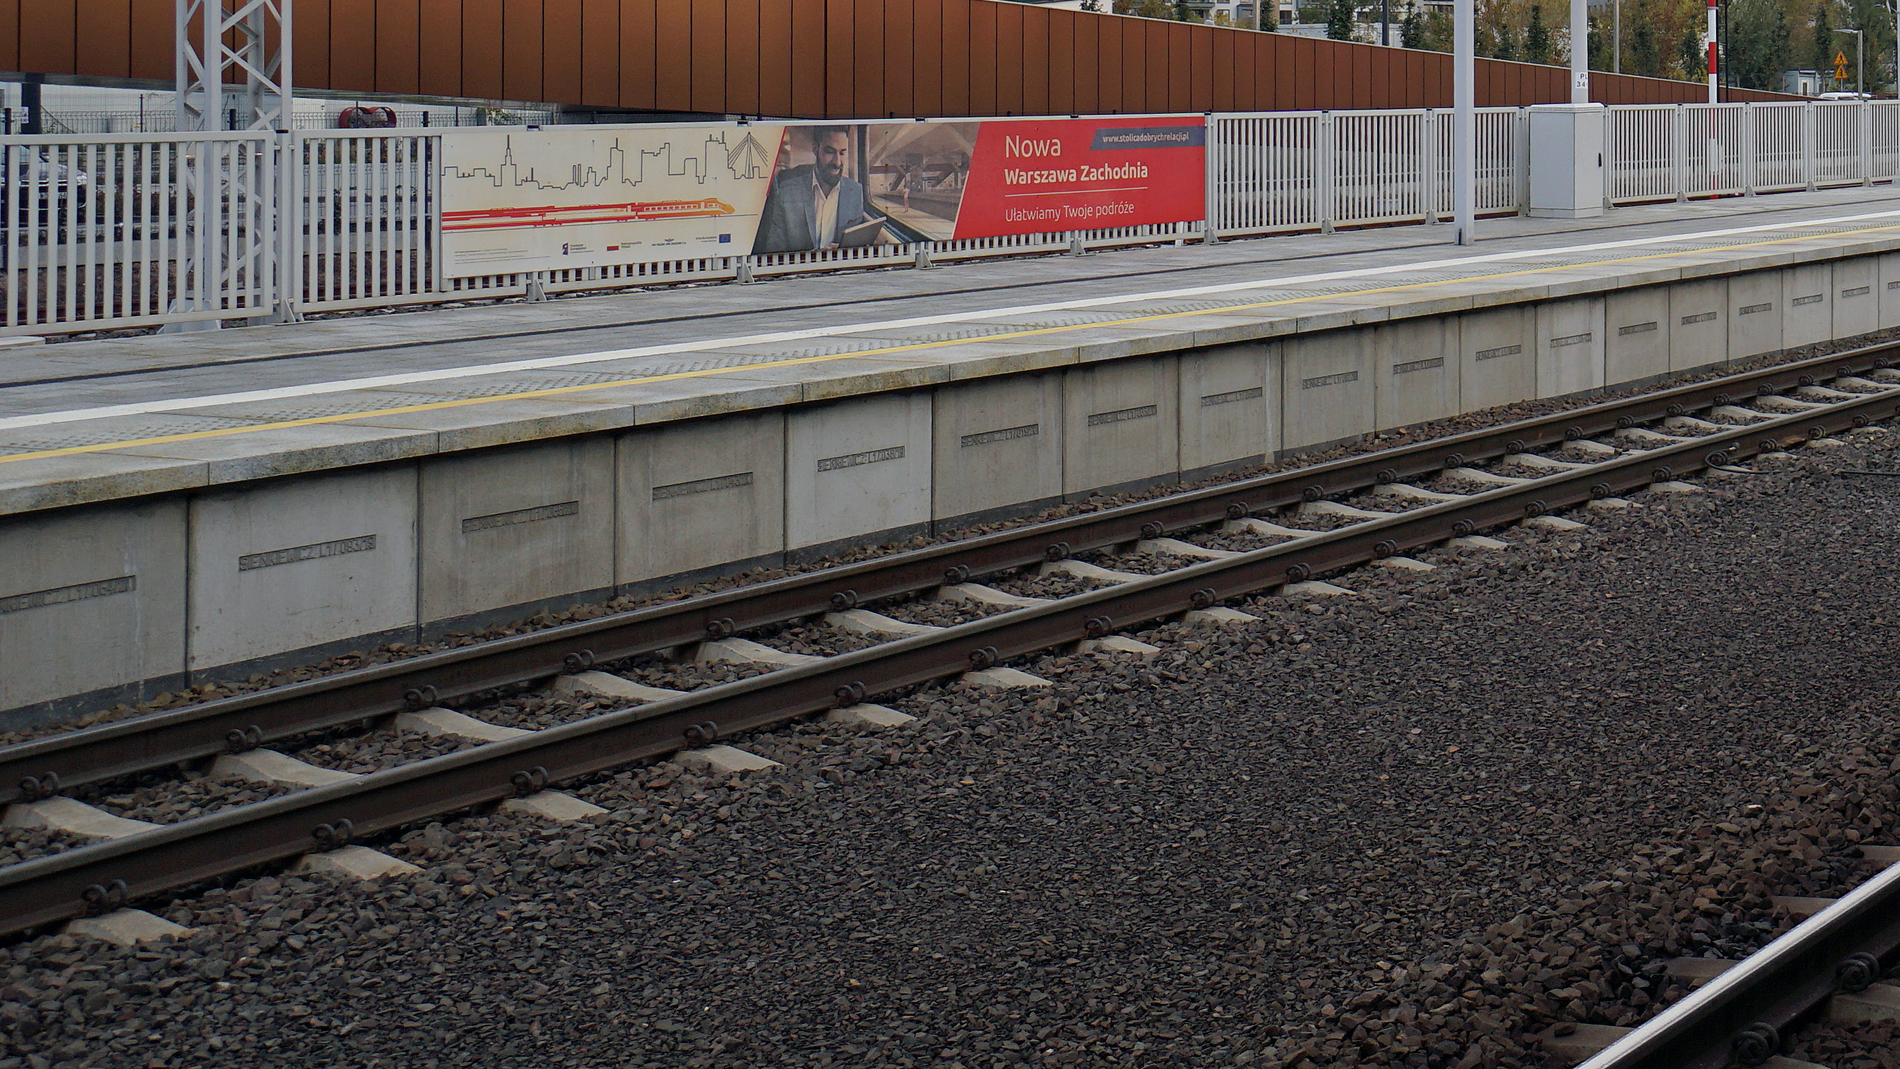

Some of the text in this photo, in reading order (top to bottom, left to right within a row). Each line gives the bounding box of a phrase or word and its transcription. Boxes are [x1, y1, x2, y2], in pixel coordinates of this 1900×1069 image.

[1005, 135, 1061, 158] Nowa
[1102, 132, 1189, 143] www.stolicadobrychrelacji.pl
[1004, 161, 1148, 185] Warszawa Zachodnia
[1005, 201, 1134, 222] Ułatwiamy Twoje podróże
